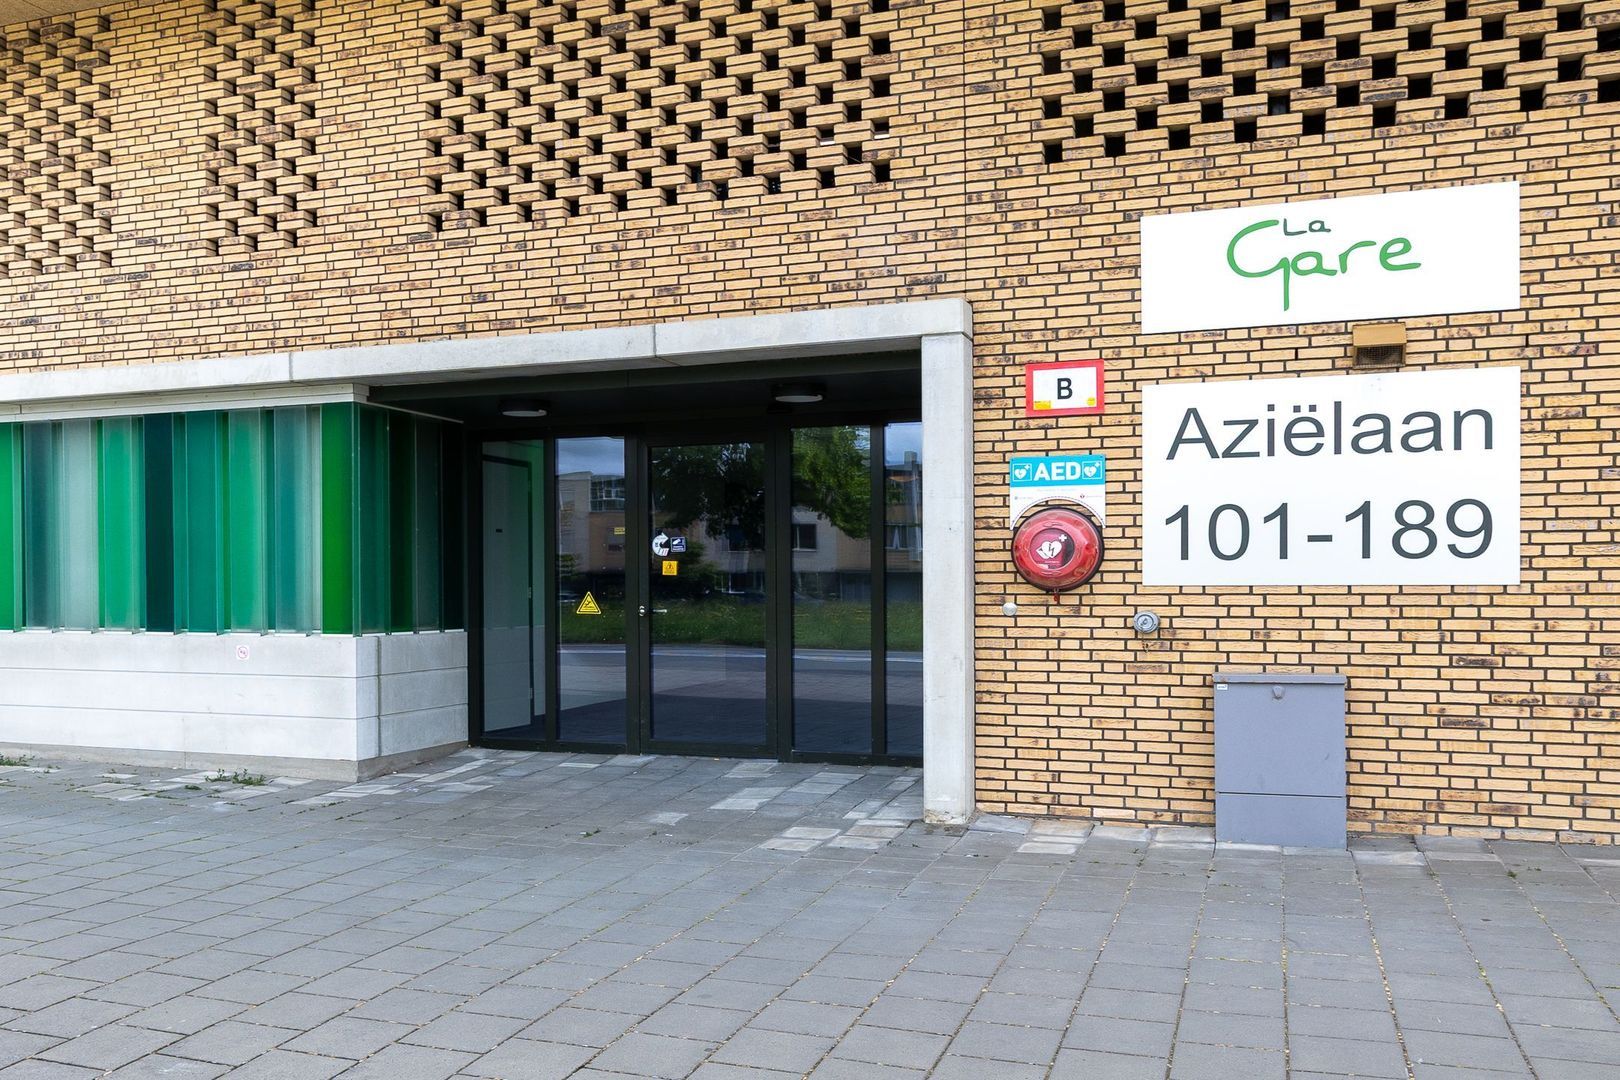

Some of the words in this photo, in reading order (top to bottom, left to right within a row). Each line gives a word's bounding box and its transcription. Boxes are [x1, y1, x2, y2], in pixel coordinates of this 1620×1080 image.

[1283, 218, 1331, 236] La
[1226, 219, 1421, 312] Gare
[1057, 377, 1073, 400] B
[1165, 400, 1494, 461] Aziëlaan
[1033, 461, 1081, 481] AED
[1165, 498, 1493, 561] 101-189
